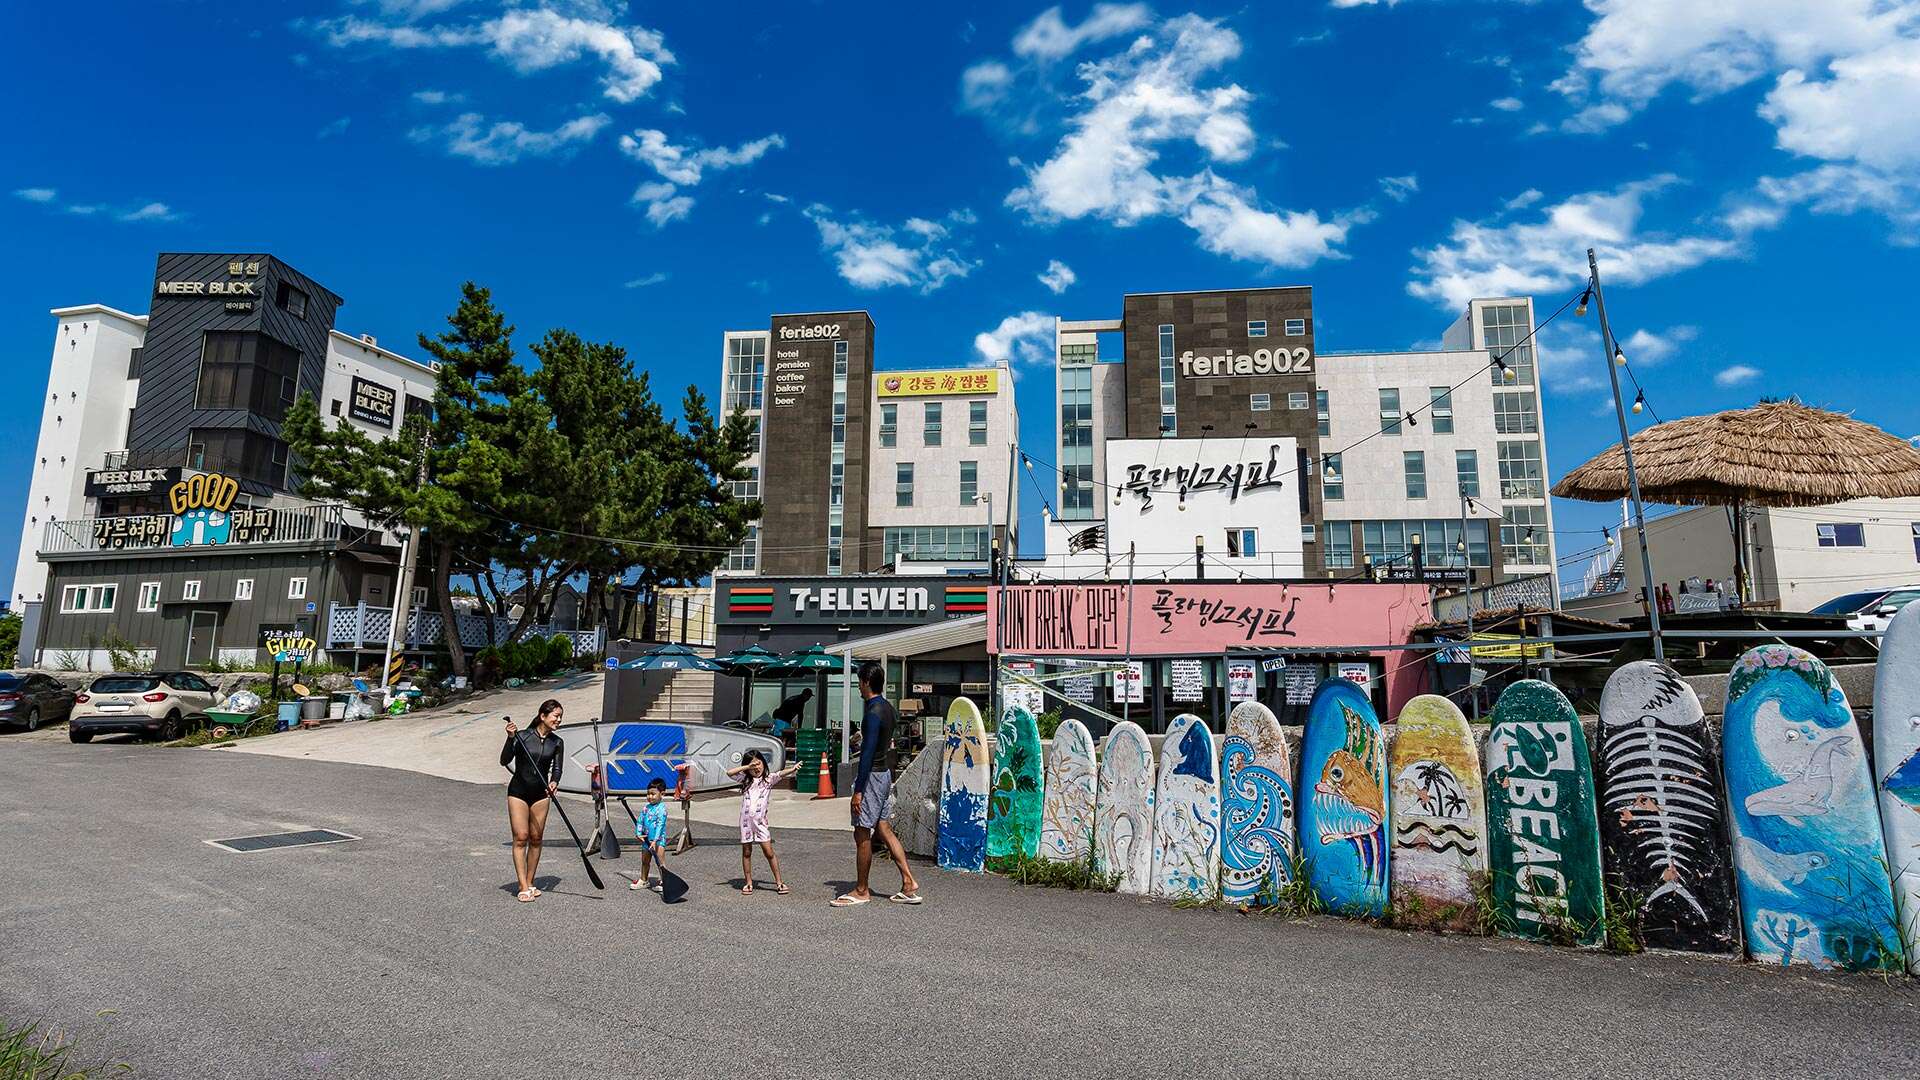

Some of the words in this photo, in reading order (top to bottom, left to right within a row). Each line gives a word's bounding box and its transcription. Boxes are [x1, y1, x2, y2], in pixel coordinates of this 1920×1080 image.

[228, 262, 260, 275] 펜션
[159, 281, 204, 295] MEER
[209, 281, 255, 296] BLICK
[780, 325, 840, 339] feria902
[777, 350, 799, 359] hotel
[1180, 347, 1311, 376] feria902
[775, 361, 810, 372] pension
[776, 374, 804, 382] coffee
[908, 376, 936, 391] 강릉
[960, 375, 988, 389] 짬뽕
[357, 381, 393, 404] MEER
[775, 384, 806, 394] bakery
[355, 394, 391, 416] BLICK
[775, 397, 795, 405] beer
[93, 471, 128, 485] MEER
[129, 468, 168, 483] BLICK
[169, 473, 238, 515] GOOD
[94, 515, 167, 547] 강릉여행
[234, 509, 273, 541] 캠핑
[1087, 589, 1118, 649] 라면
[1264, 658, 1285, 670] OPEN
[1509, 777, 1568, 926] BEACH
